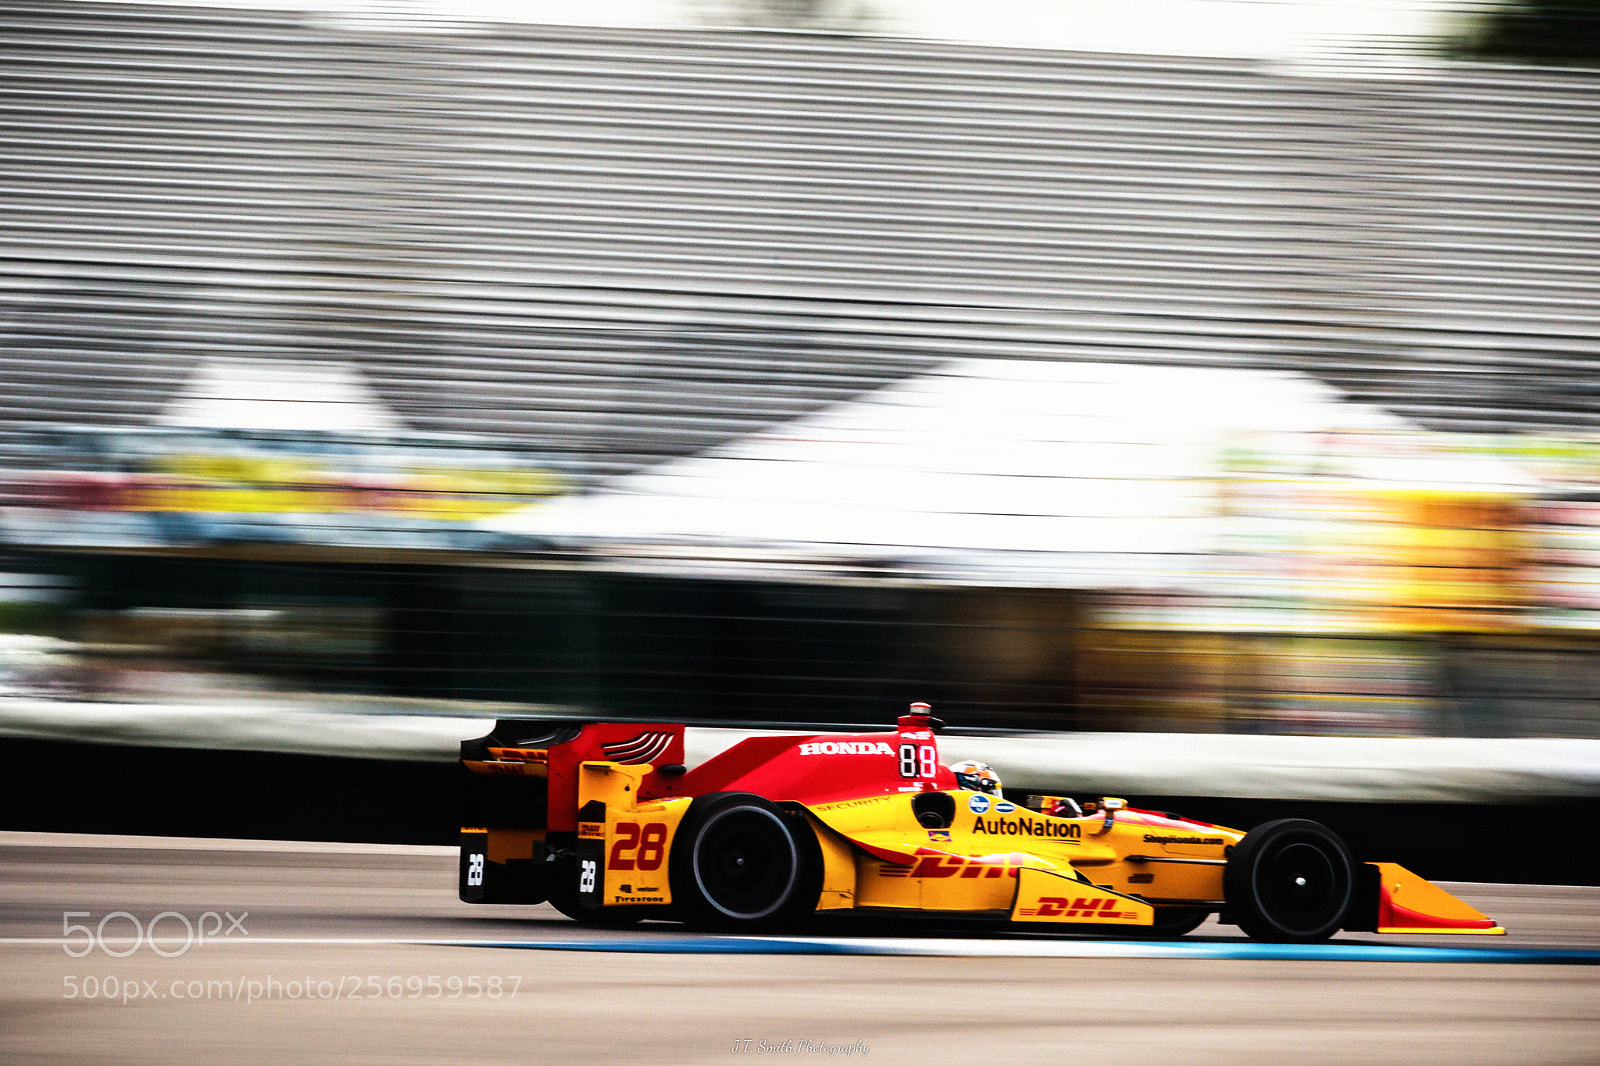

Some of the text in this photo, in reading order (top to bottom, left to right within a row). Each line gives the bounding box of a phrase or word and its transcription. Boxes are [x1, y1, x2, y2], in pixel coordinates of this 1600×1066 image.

[799, 742, 895, 756] HONDA
[817, 797, 891, 812] SECURITY
[972, 817, 1081, 838] AutoNation
[608, 822, 667, 871] 28
[467, 853, 484, 886] 28
[580, 860, 596, 893] 28
[615, 895, 664, 903] Firestone
[1036, 897, 1123, 918] DHL
